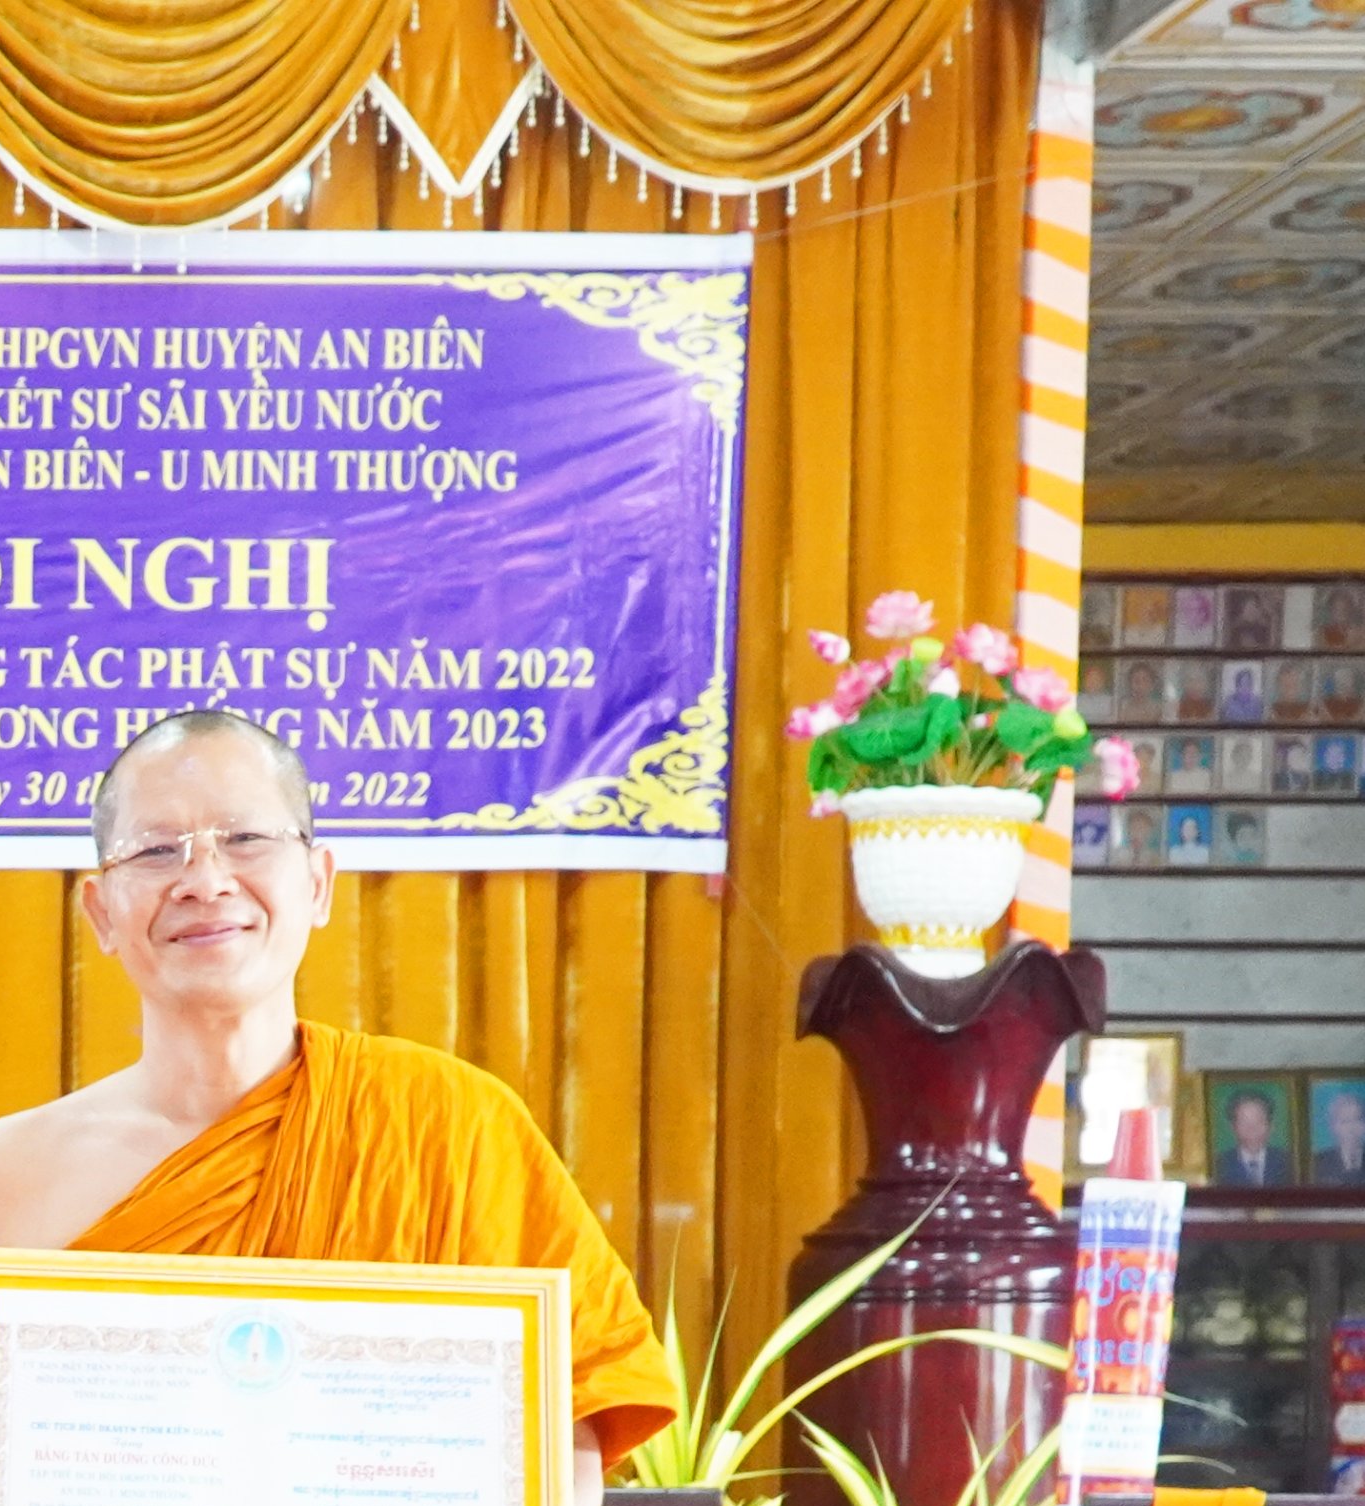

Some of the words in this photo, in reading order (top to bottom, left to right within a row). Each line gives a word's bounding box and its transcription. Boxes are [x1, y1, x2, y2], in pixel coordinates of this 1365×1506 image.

[153, 320, 304, 382] HUYỆN
[310, 328, 371, 370] AN
[382, 315, 485, 370] BIÊN
[71, 384, 132, 430] SƯ
[138, 380, 208, 430] SÃI
[217, 378, 305, 431] YÊU
[315, 377, 443, 431] NƯỚC
[23, 437, 124, 490] BIÊN
[135, 471, 150, 481] -
[160, 450, 190, 491] U
[201, 450, 318, 491] MINH
[328, 442, 518, 503] THƯỢNG
[68, 536, 337, 631] NGHỊ
[19, 640, 125, 689] TÁC
[138, 641, 276, 700] PHẬT
[286, 640, 357, 700] SỰ
[365, 640, 483, 691] NĂM
[496, 646, 597, 690] 2022
[316, 698, 432, 750] NĂM
[446, 707, 548, 750] 2023
[20, 772, 68, 806] 30
[340, 772, 432, 807] 2022
